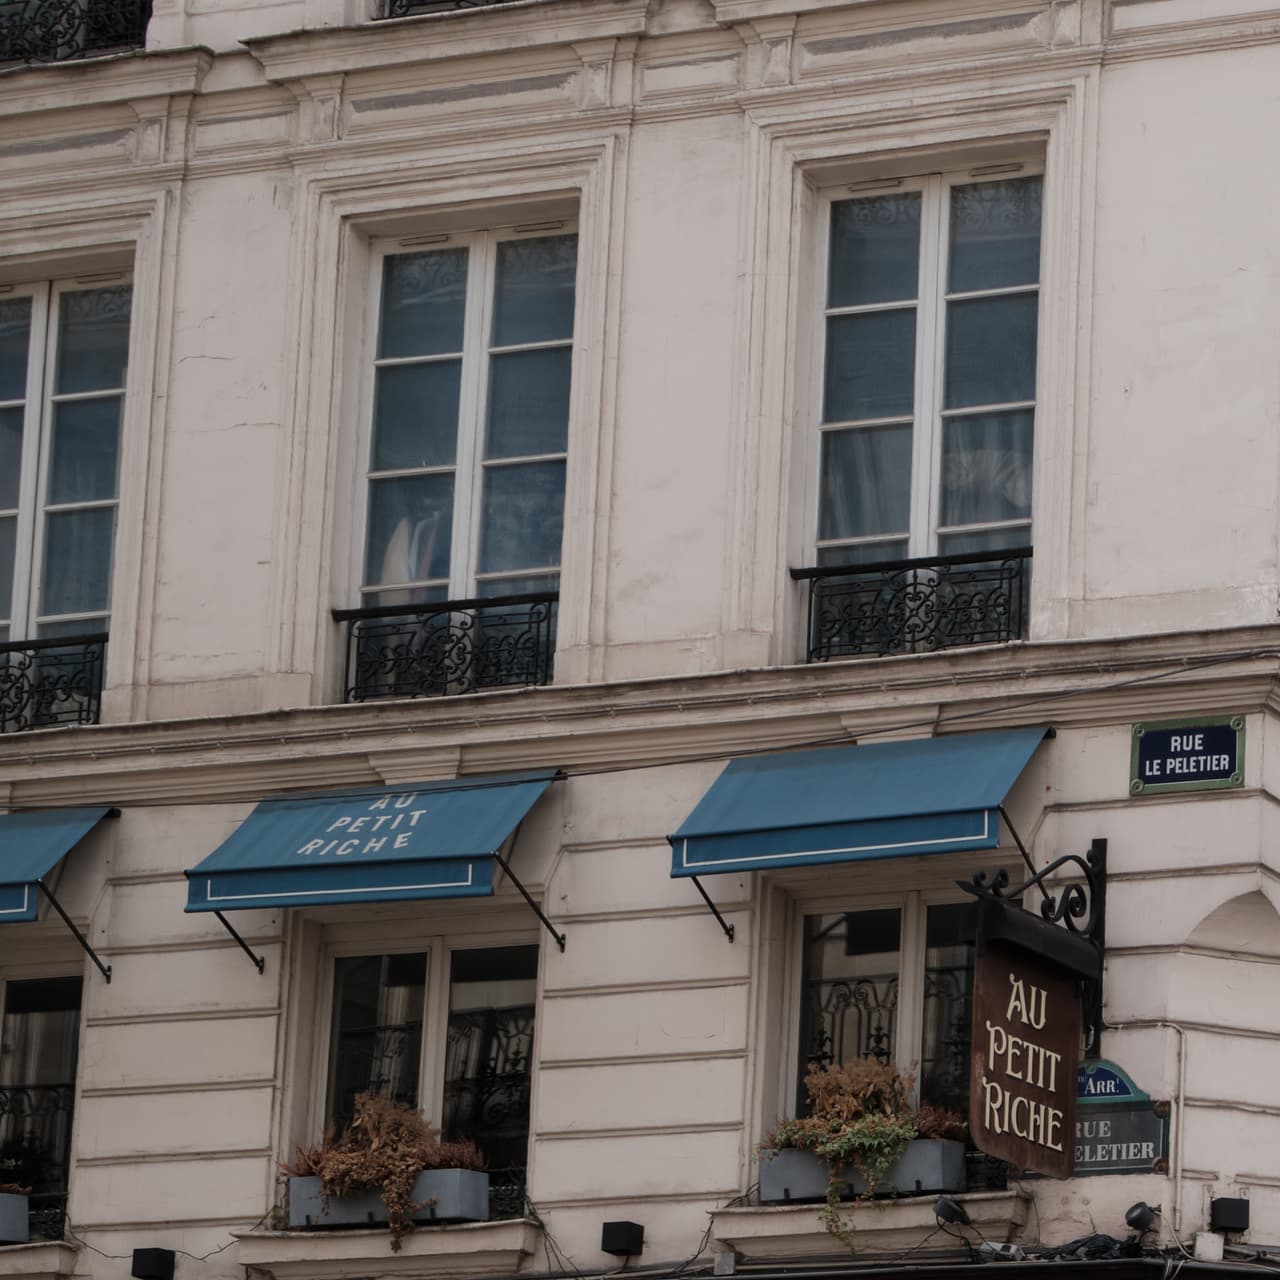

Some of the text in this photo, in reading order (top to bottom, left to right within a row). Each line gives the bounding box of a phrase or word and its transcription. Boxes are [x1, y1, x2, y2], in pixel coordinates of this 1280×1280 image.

[1171, 734, 1204, 752] RUE
[1145, 754, 1230, 776] LE PELETIER
[368, 791, 418, 810] AU
[326, 810, 427, 832] PETIT
[297, 832, 412, 855] RICHE
[1006, 973, 1048, 1030] AU
[985, 1020, 1062, 1093] PETIT
[982, 1076, 1064, 1152] RICHE
